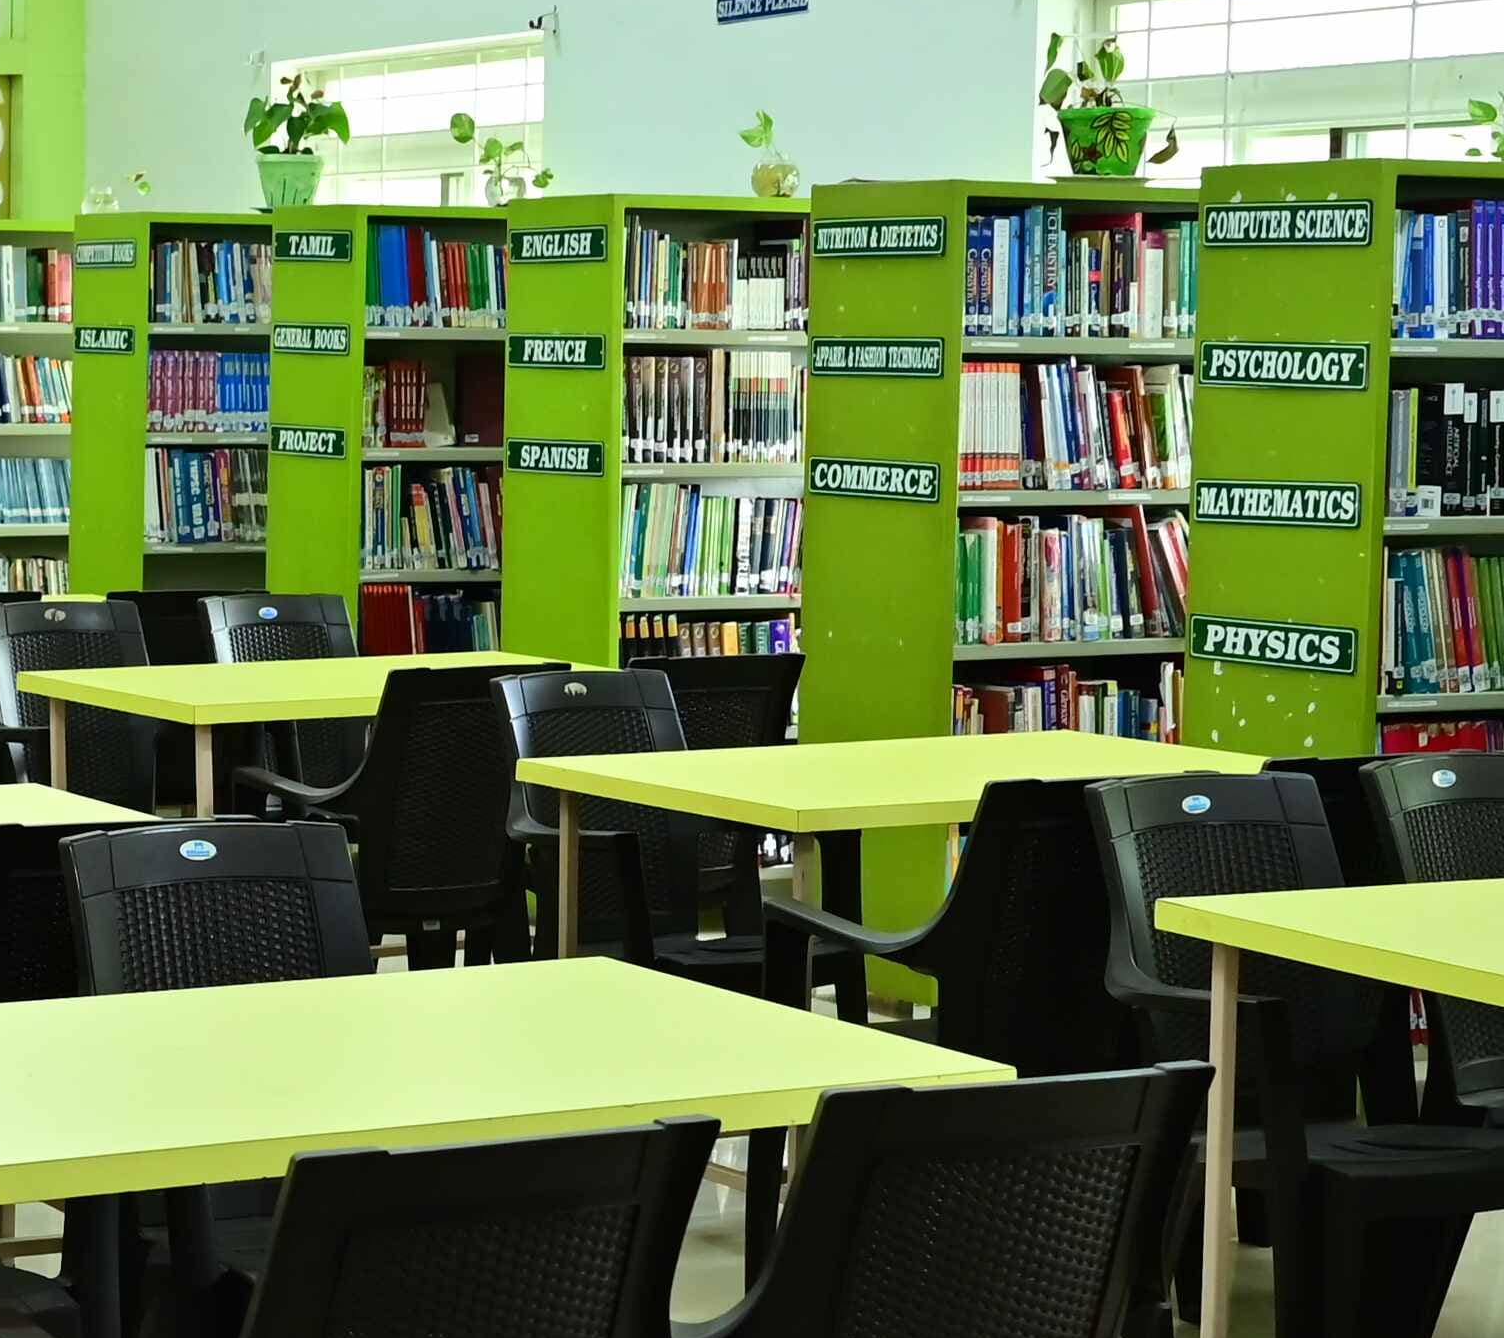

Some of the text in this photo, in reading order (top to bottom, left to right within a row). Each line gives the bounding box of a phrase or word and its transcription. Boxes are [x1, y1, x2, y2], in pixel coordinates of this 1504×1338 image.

[1207, 207, 1368, 240] COMPUTER SCIENCE
[288, 235, 337, 257] TAMIL
[522, 233, 592, 258] ENGLISH
[816, 224, 938, 250] NUTRITION & DIETETICS
[79, 329, 129, 350] ISLAMIC
[274, 328, 347, 350] GENERAL BOOKS
[522, 340, 587, 363] FRENCH
[816, 346, 846, 367] APPAREL
[855, 346, 887, 368] FASHION
[888, 346, 939, 369] TECHNOLOGY
[1210, 349, 1357, 382] PSYCHOLOGY
[278, 429, 336, 453] PROJECT
[520, 445, 590, 470] SPANISH
[814, 463, 934, 495] COMMERCE
[1199, 485, 1355, 520] MATHEMATICS
[1205, 624, 1341, 665] PHYSICS
